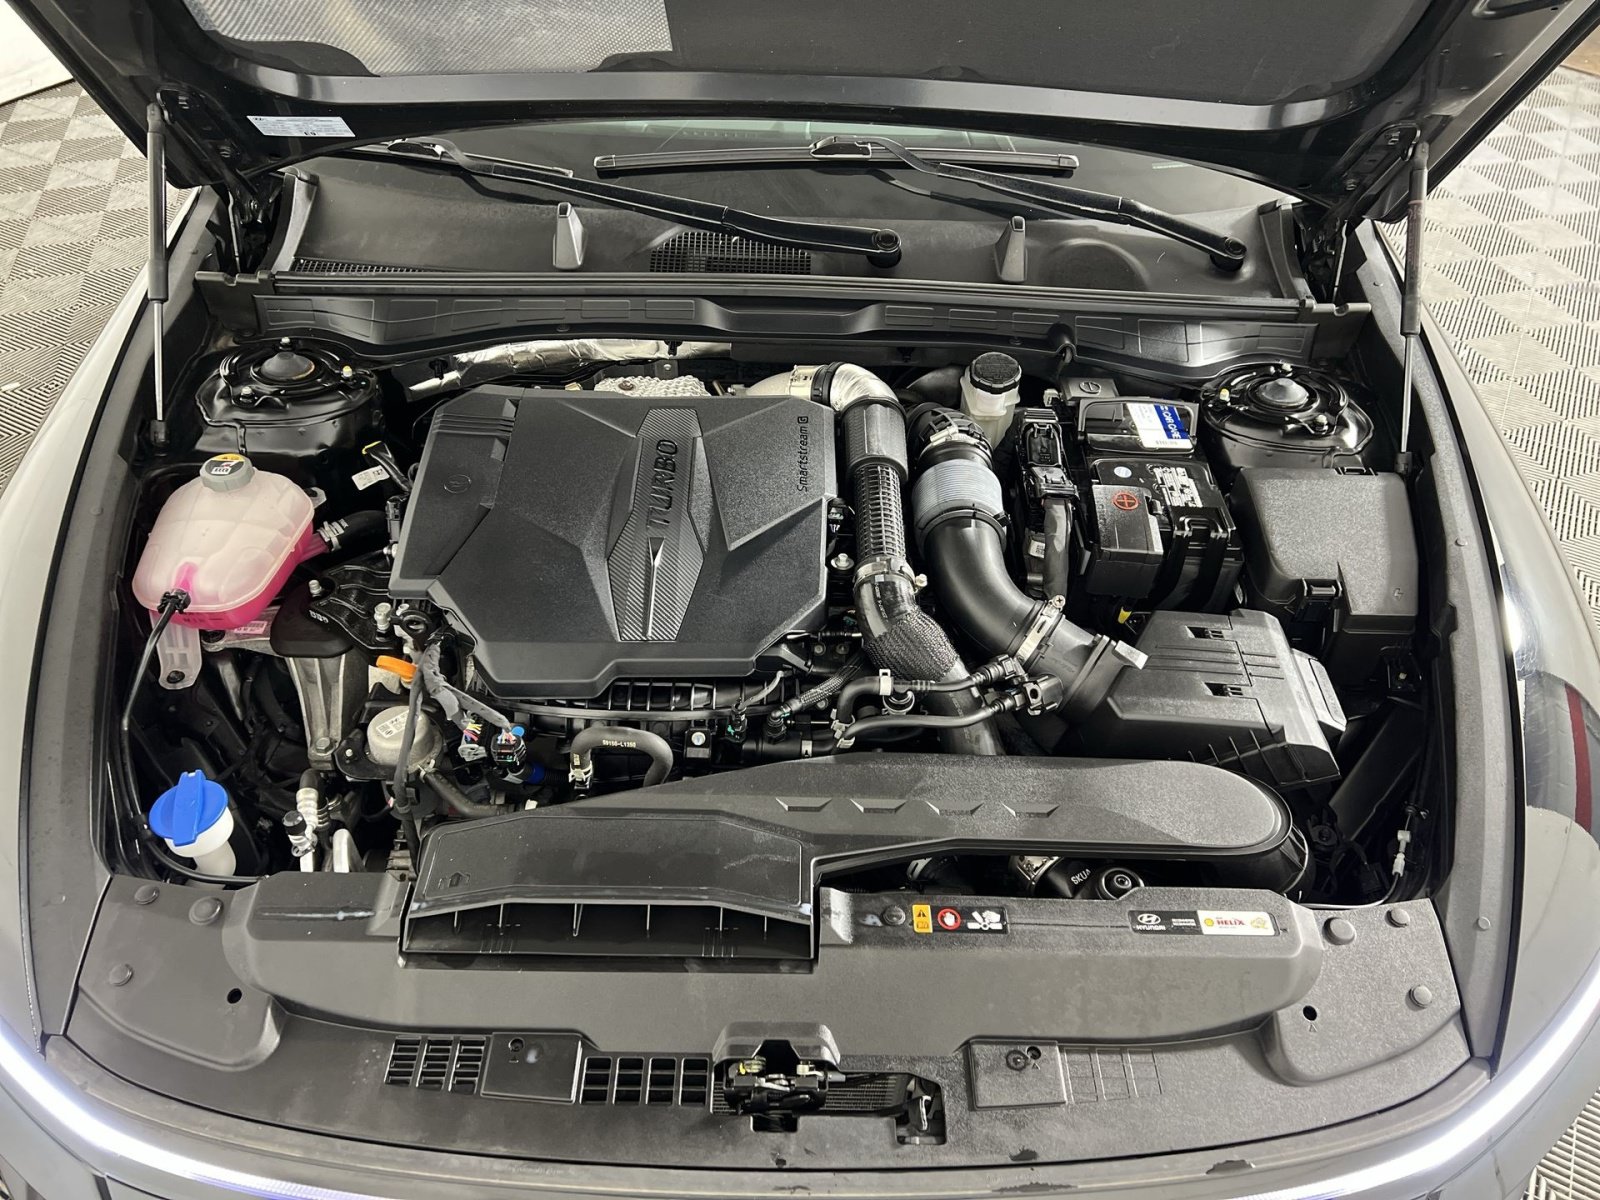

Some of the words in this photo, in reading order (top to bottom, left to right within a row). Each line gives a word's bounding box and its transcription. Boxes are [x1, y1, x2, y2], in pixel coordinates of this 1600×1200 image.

[647, 440, 678, 528] TURBO
[797, 426, 808, 492] Smartstream
[1216, 918, 1245, 926] HELIX
